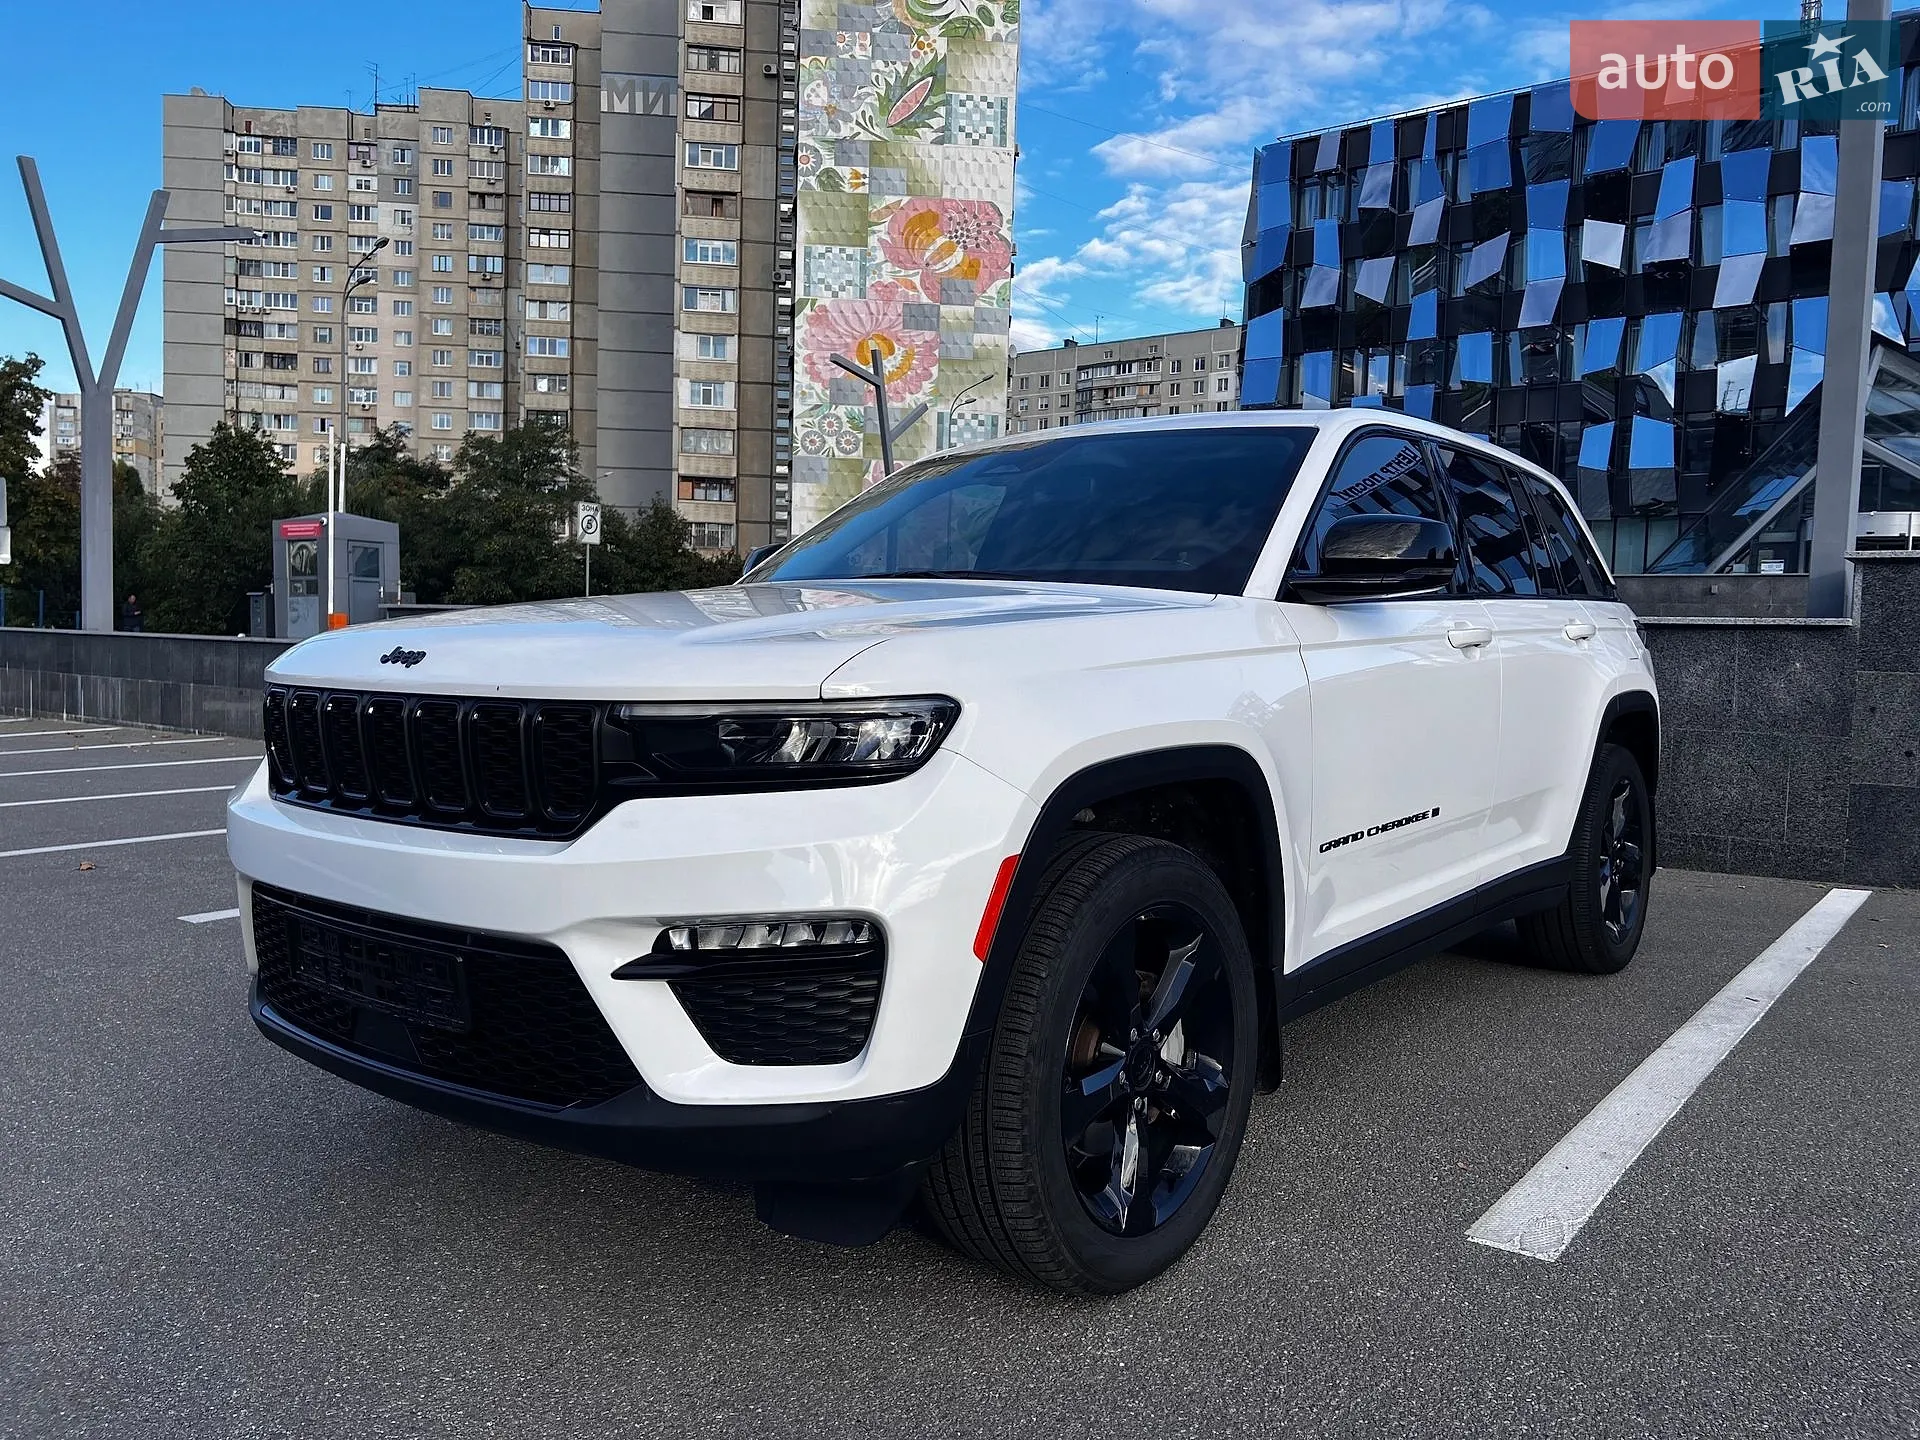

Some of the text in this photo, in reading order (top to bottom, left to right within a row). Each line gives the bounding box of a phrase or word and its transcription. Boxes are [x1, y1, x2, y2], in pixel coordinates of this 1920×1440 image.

[581, 504, 599, 512] ЗОНА
[380, 646, 427, 668] Jeep
[1319, 810, 1430, 853] GRAND CHEROKEE
